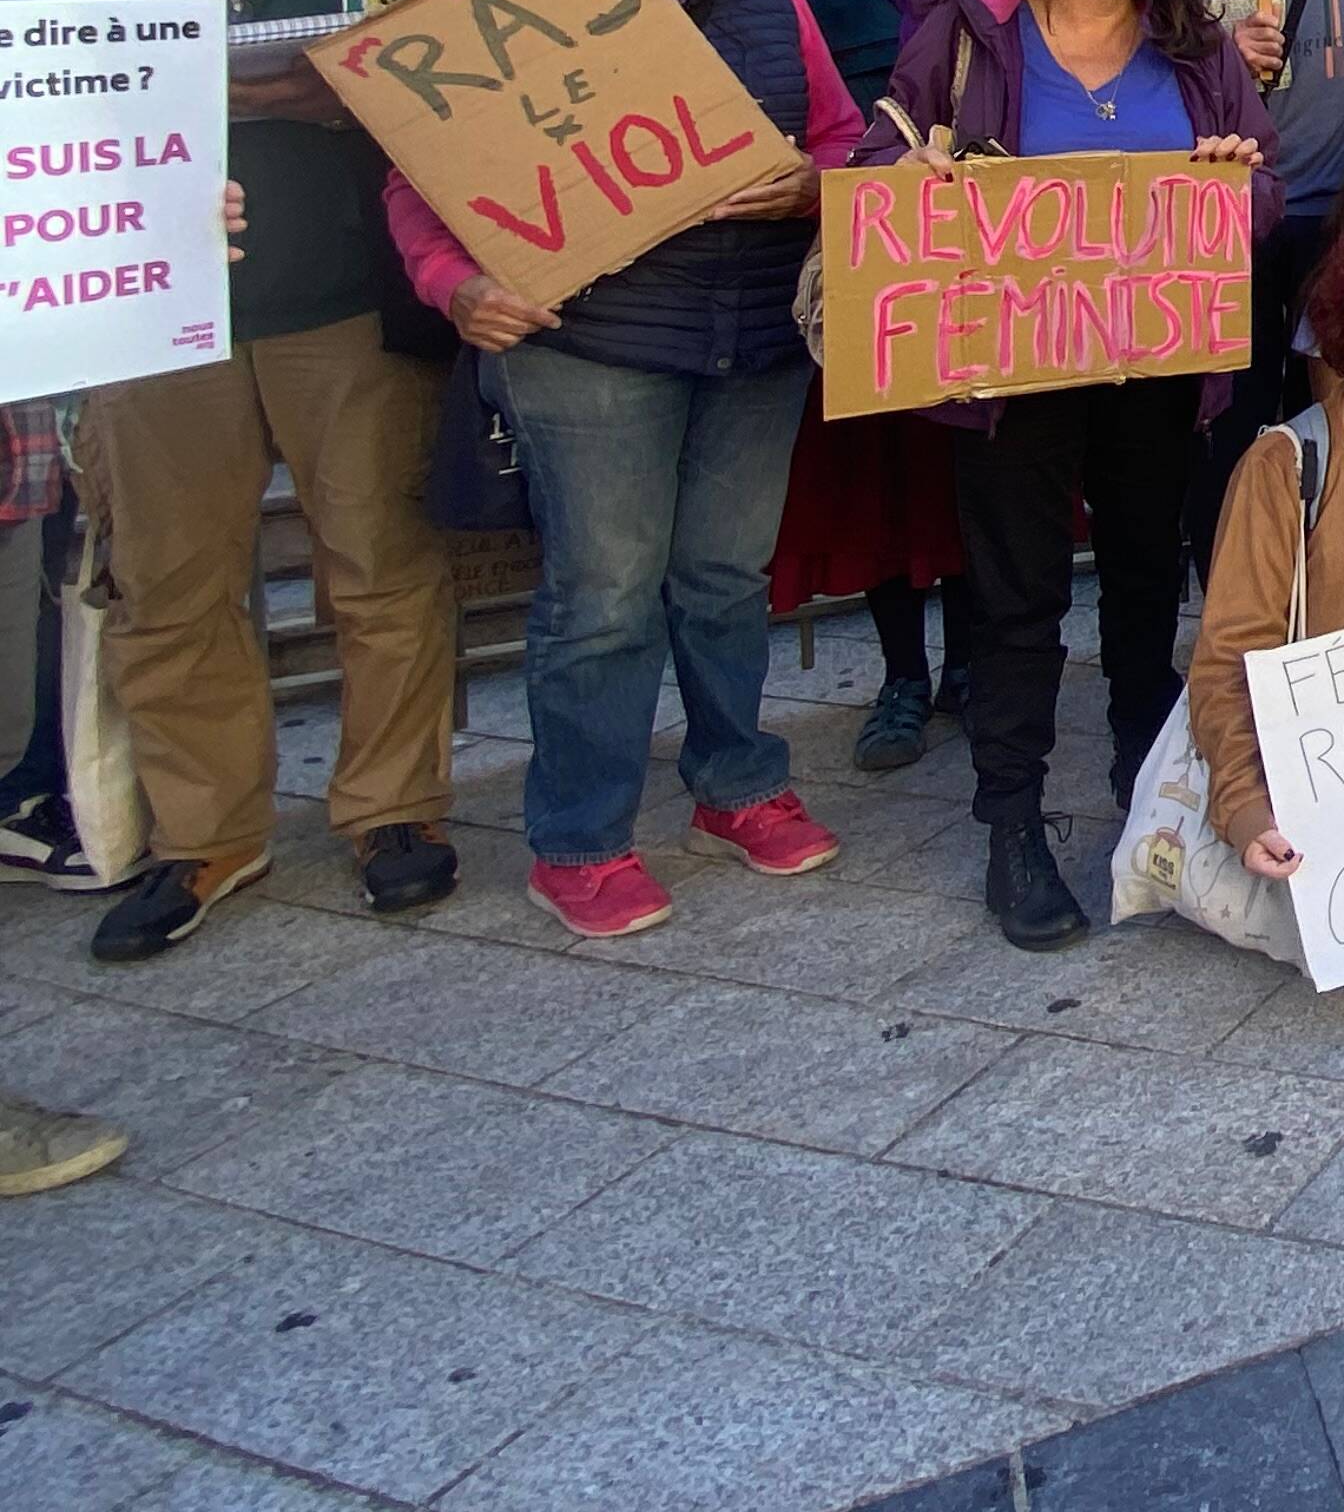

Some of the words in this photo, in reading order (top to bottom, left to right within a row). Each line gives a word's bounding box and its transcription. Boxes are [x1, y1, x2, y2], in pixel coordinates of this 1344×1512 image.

[24, 19, 98, 47] dire
[107, 17, 126, 42] à
[137, 20, 200, 42] une
[6, 139, 122, 179] SUIS
[135, 133, 192, 167] LA
[467, 95, 755, 253] VIOL
[4, 201, 146, 247] POUR
